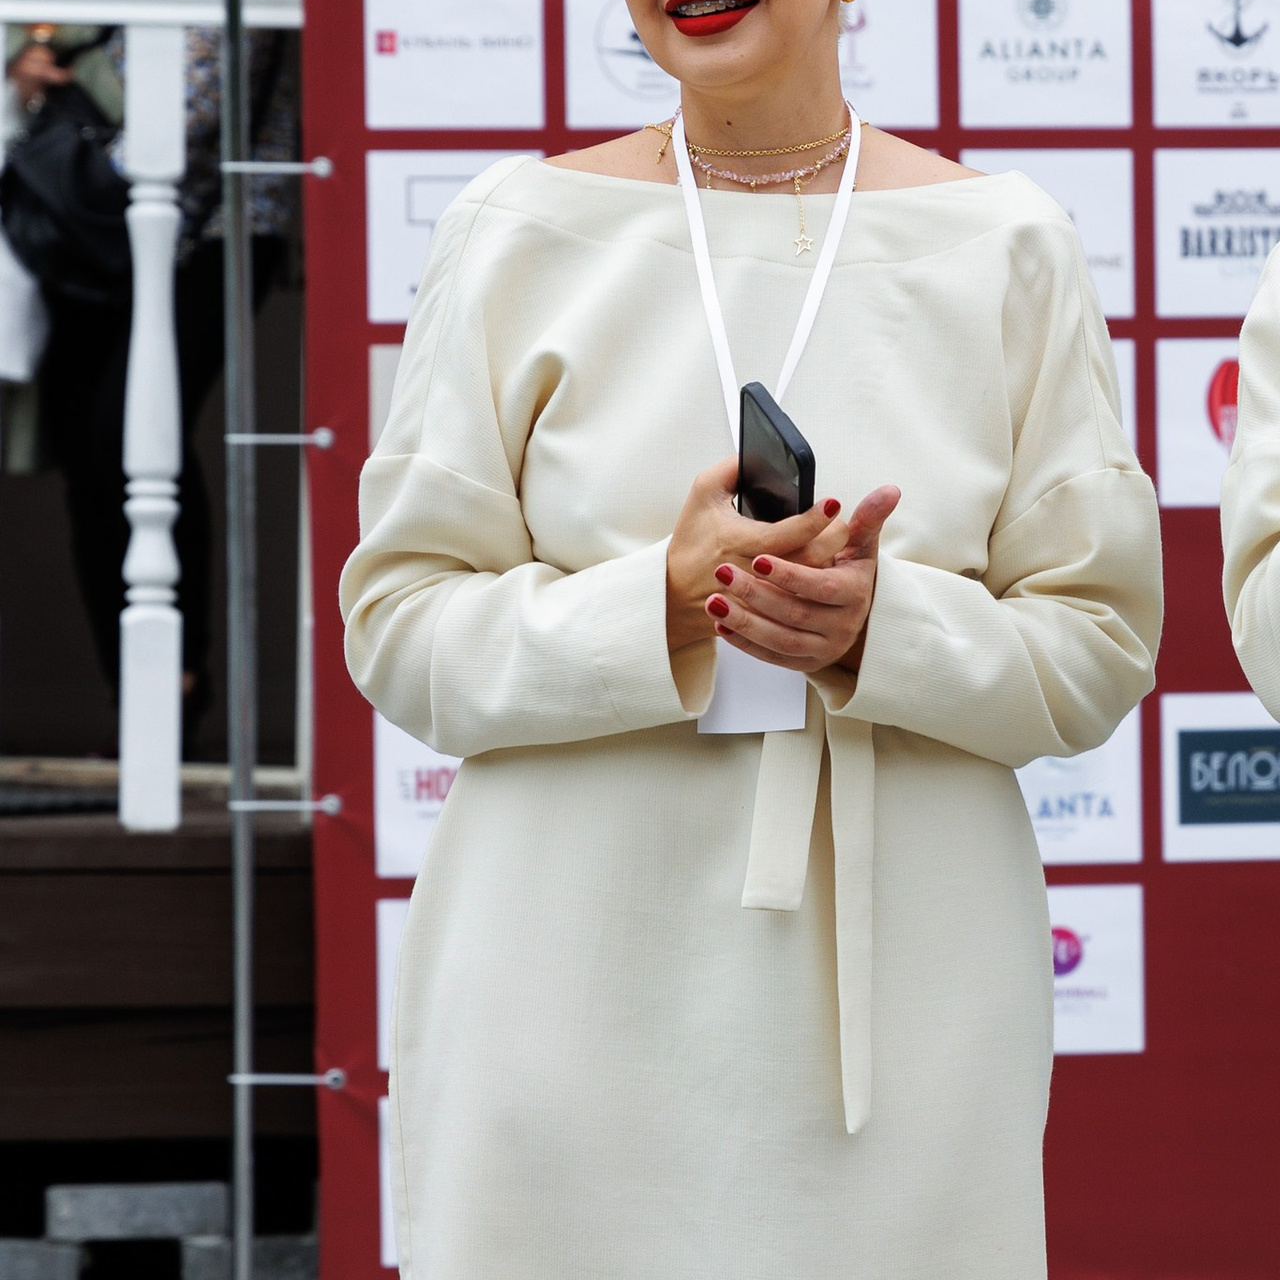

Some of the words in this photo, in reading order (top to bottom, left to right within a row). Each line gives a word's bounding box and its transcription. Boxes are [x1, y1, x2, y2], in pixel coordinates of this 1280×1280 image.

[979, 39, 1108, 59] ALIANTA
[1007, 66, 1079, 83] GROUP
[1197, 67, 1280, 84] ЯКОРЬ
[1031, 792, 1116, 819] ANTA
